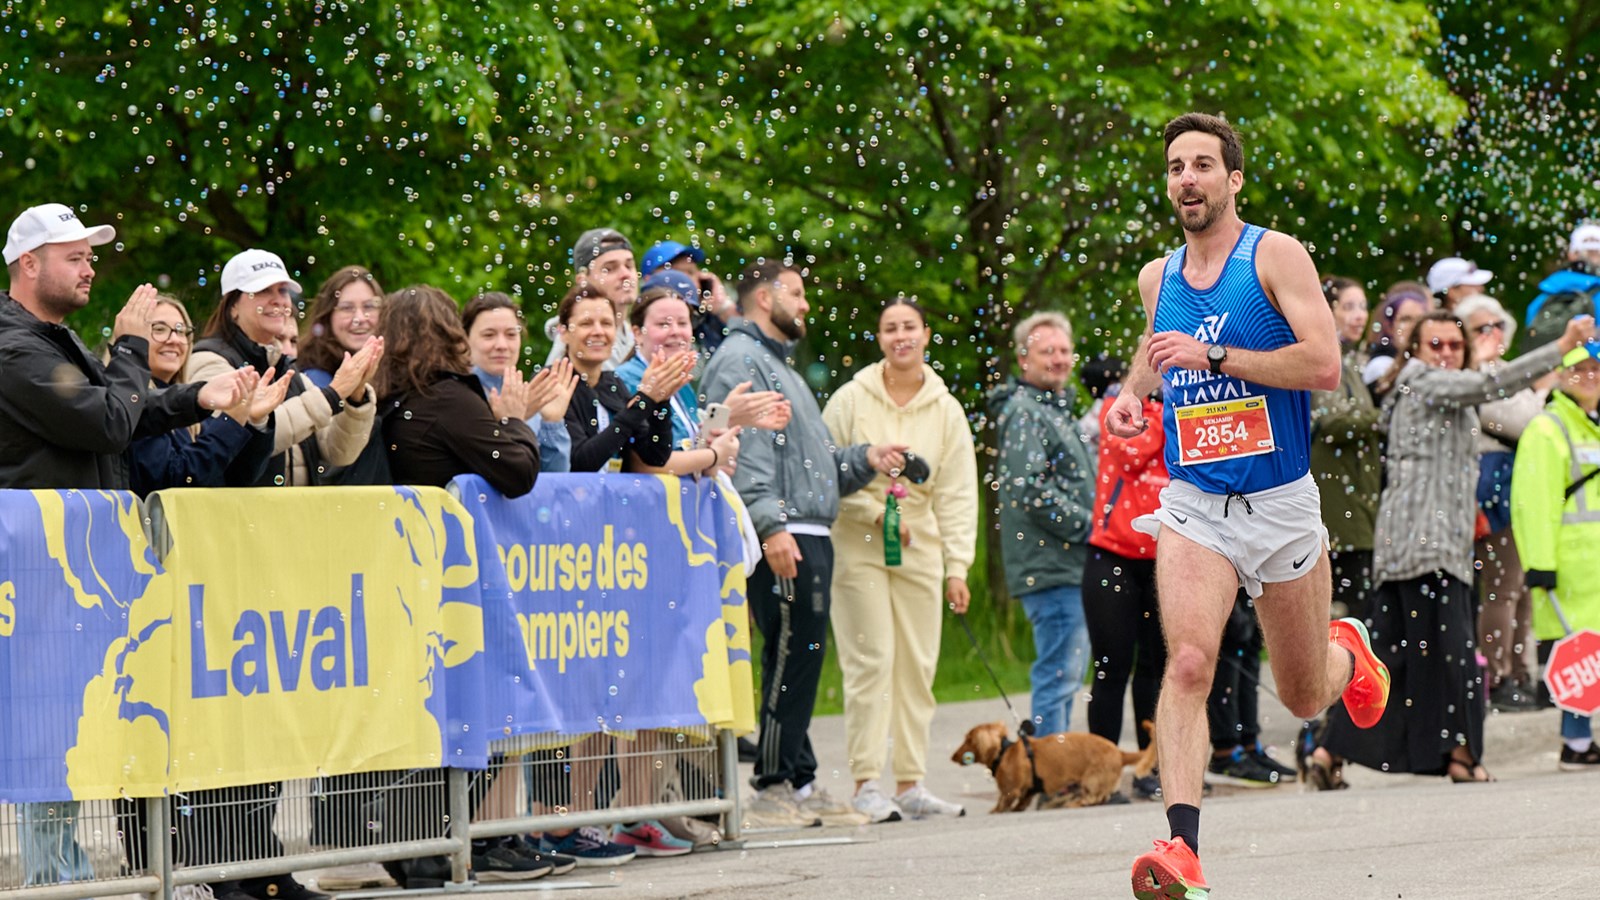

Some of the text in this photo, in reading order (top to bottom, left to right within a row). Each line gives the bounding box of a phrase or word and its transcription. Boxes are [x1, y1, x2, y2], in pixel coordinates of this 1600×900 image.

[1183, 380, 1252, 406] LAVAL
[1203, 415, 1234, 426] BENJAMIN
[1217, 405, 1228, 413] KM
[1194, 420, 1249, 448] 2854
[596, 524, 648, 590] des
[188, 573, 368, 699] Laval
[516, 600, 630, 673] mpiers
